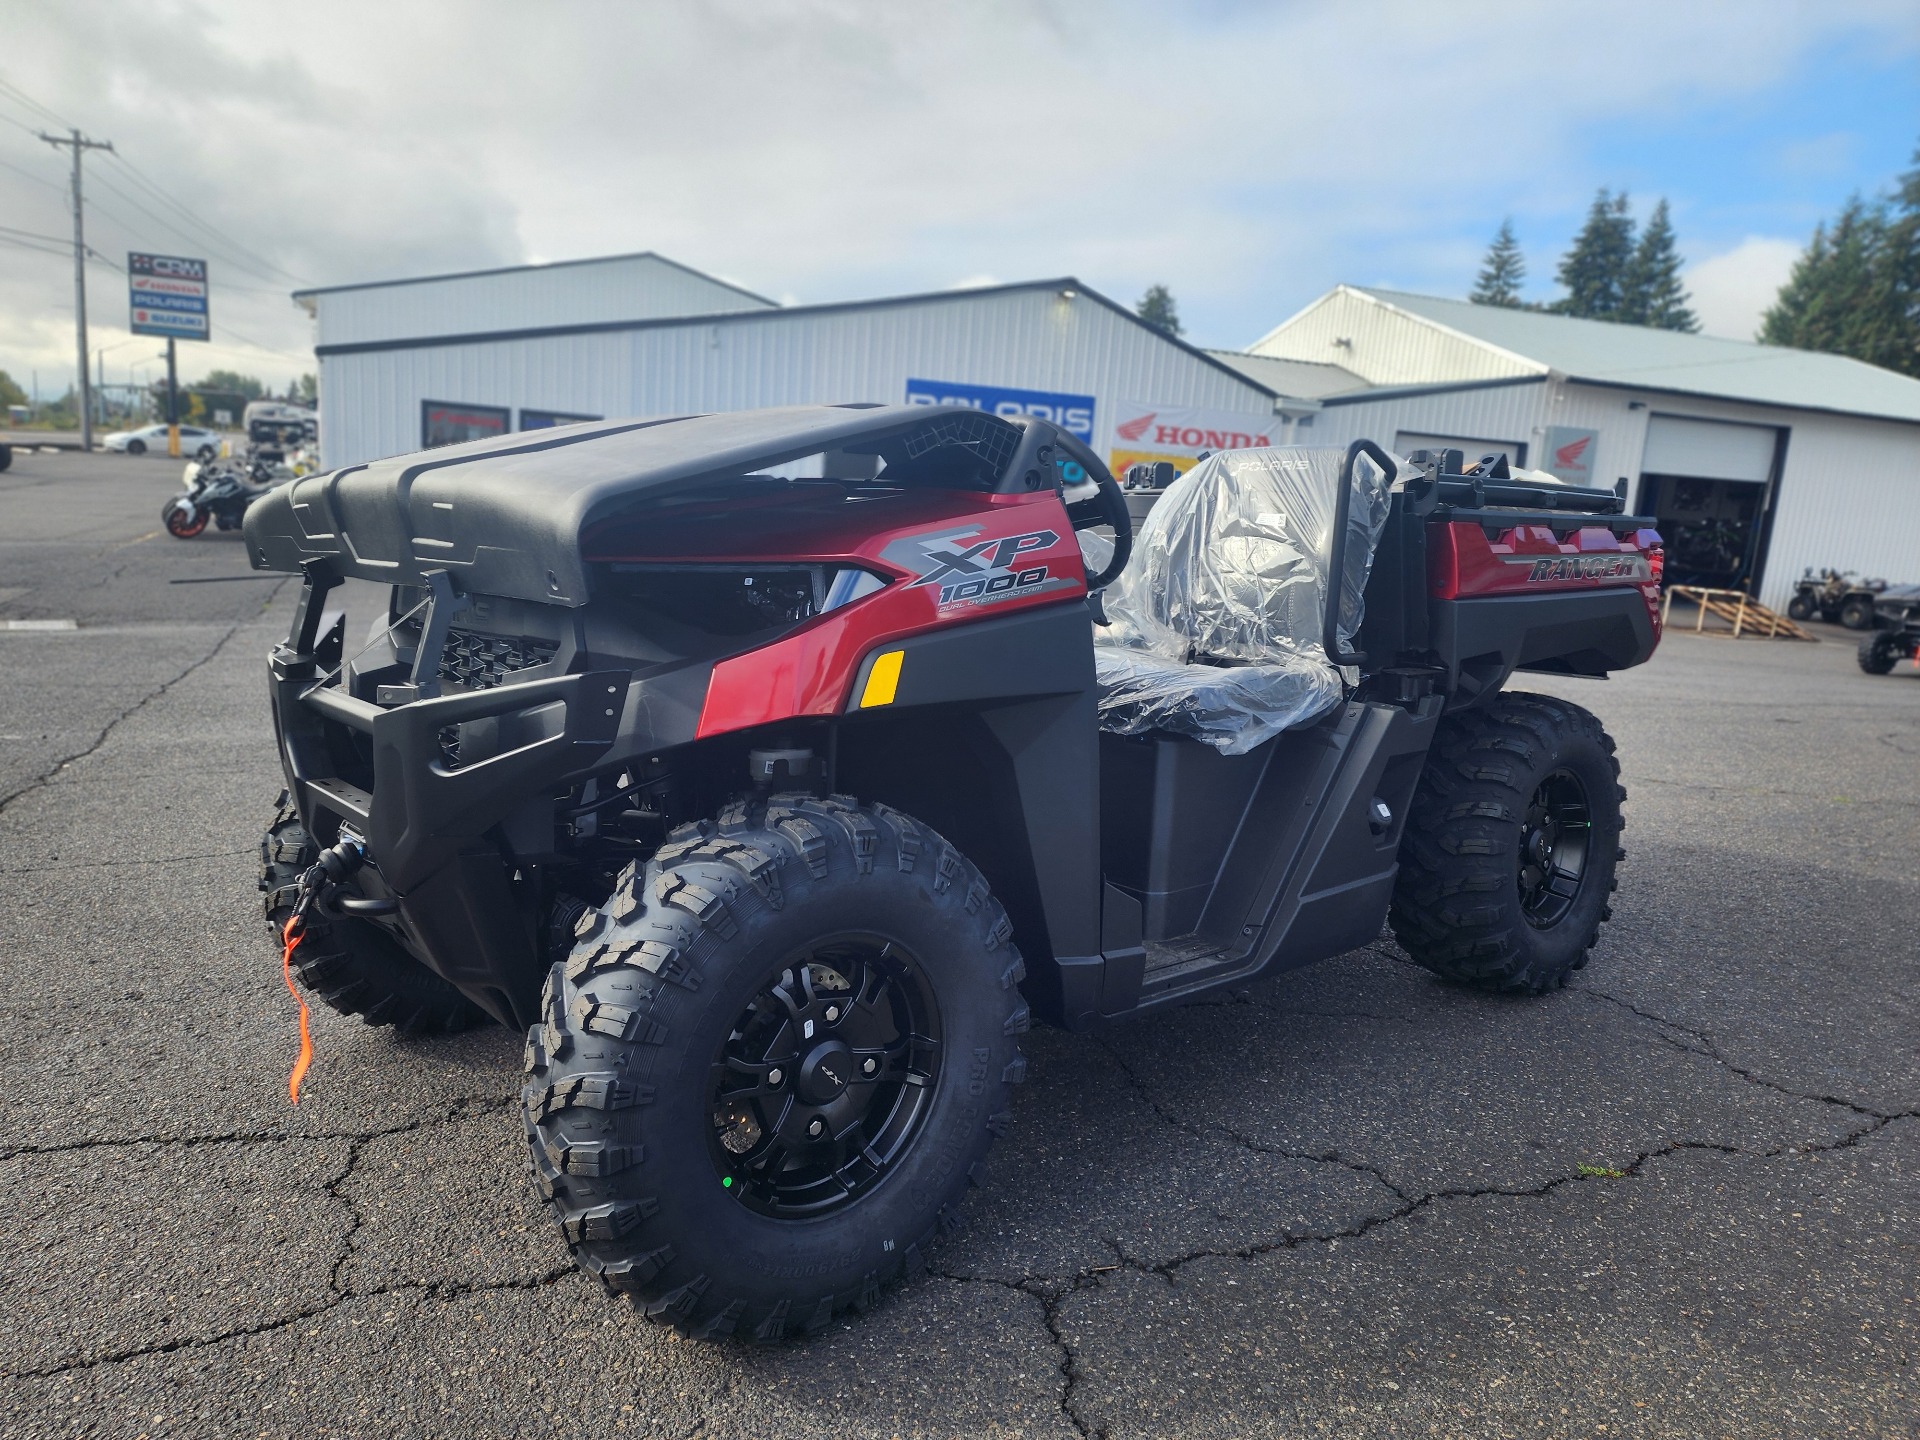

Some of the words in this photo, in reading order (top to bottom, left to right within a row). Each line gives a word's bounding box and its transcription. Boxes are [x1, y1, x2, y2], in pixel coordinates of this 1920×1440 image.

[152, 258, 203, 279] CRM
[134, 294, 203, 311] POLARIS
[1155, 425, 1271, 449] HONDA
[1238, 460, 1309, 473] POLARIS
[901, 529, 1060, 591] XP
[1527, 556, 1637, 582] RANGER
[938, 566, 1048, 606] 1000
[939, 602, 965, 613] DUAL
[967, 590, 1020, 606] OVERHEAD
[1022, 585, 1043, 595] CAM
